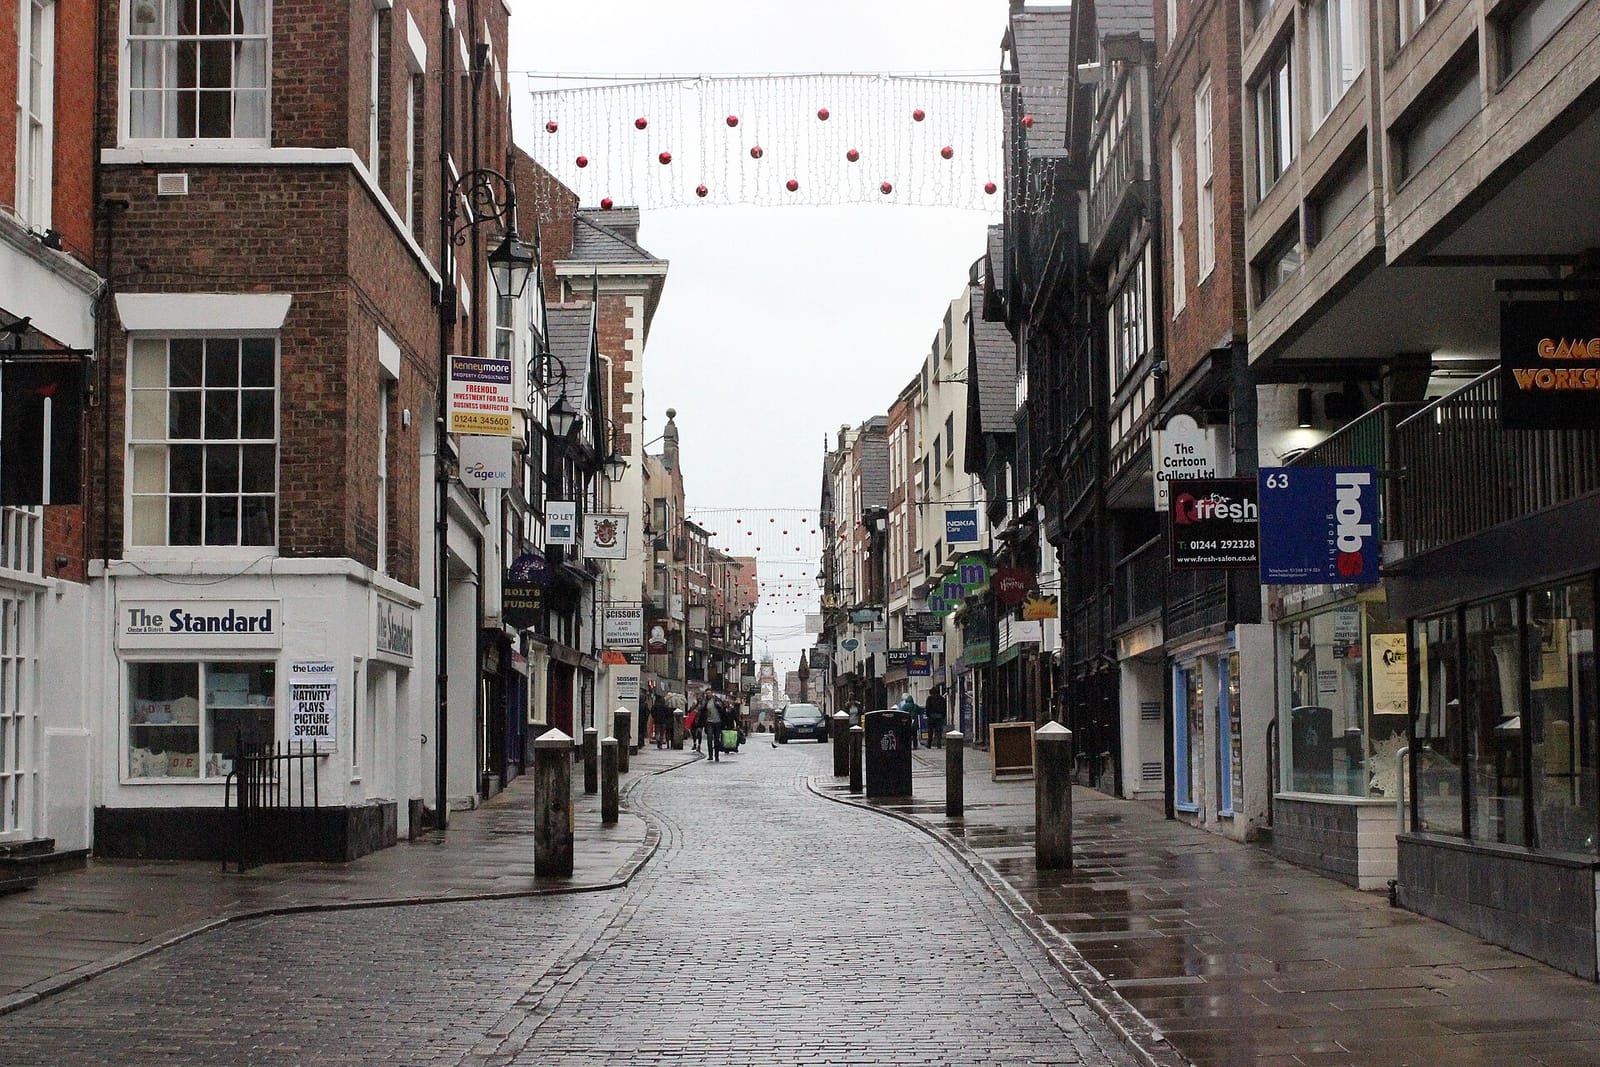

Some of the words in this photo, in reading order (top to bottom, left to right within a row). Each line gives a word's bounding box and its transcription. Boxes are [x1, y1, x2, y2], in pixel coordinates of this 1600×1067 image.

[1512, 368, 1600, 391] WORKS
[466, 384, 498, 394] FREEHOLD
[453, 393, 486, 401] INVESTMENT
[479, 403, 509, 411] UNAFFECTED
[454, 415, 477, 423] 01244
[480, 416, 509, 426] 345600
[1174, 443, 1194, 454] The
[1163, 457, 1206, 468] Cartoon
[1266, 473, 1289, 489] 63
[1195, 498, 1258, 519] fresh
[1190, 540, 1217, 550] 01244
[1220, 540, 1256, 549] 292328
[1326, 513, 1337, 577] graphics
[504, 588, 541, 596] ROLY'S
[504, 600, 541, 609] FUDGE
[128, 608, 164, 627] The
[169, 608, 272, 632] Standard
[606, 610, 641, 619] SCISSORS
[307, 664, 335, 672] Leader
[293, 690, 331, 701] NATIVITY
[299, 702, 325, 713] PLAYS
[294, 714, 330, 725] PICTURE
[294, 725, 329, 736] SPECIAL
